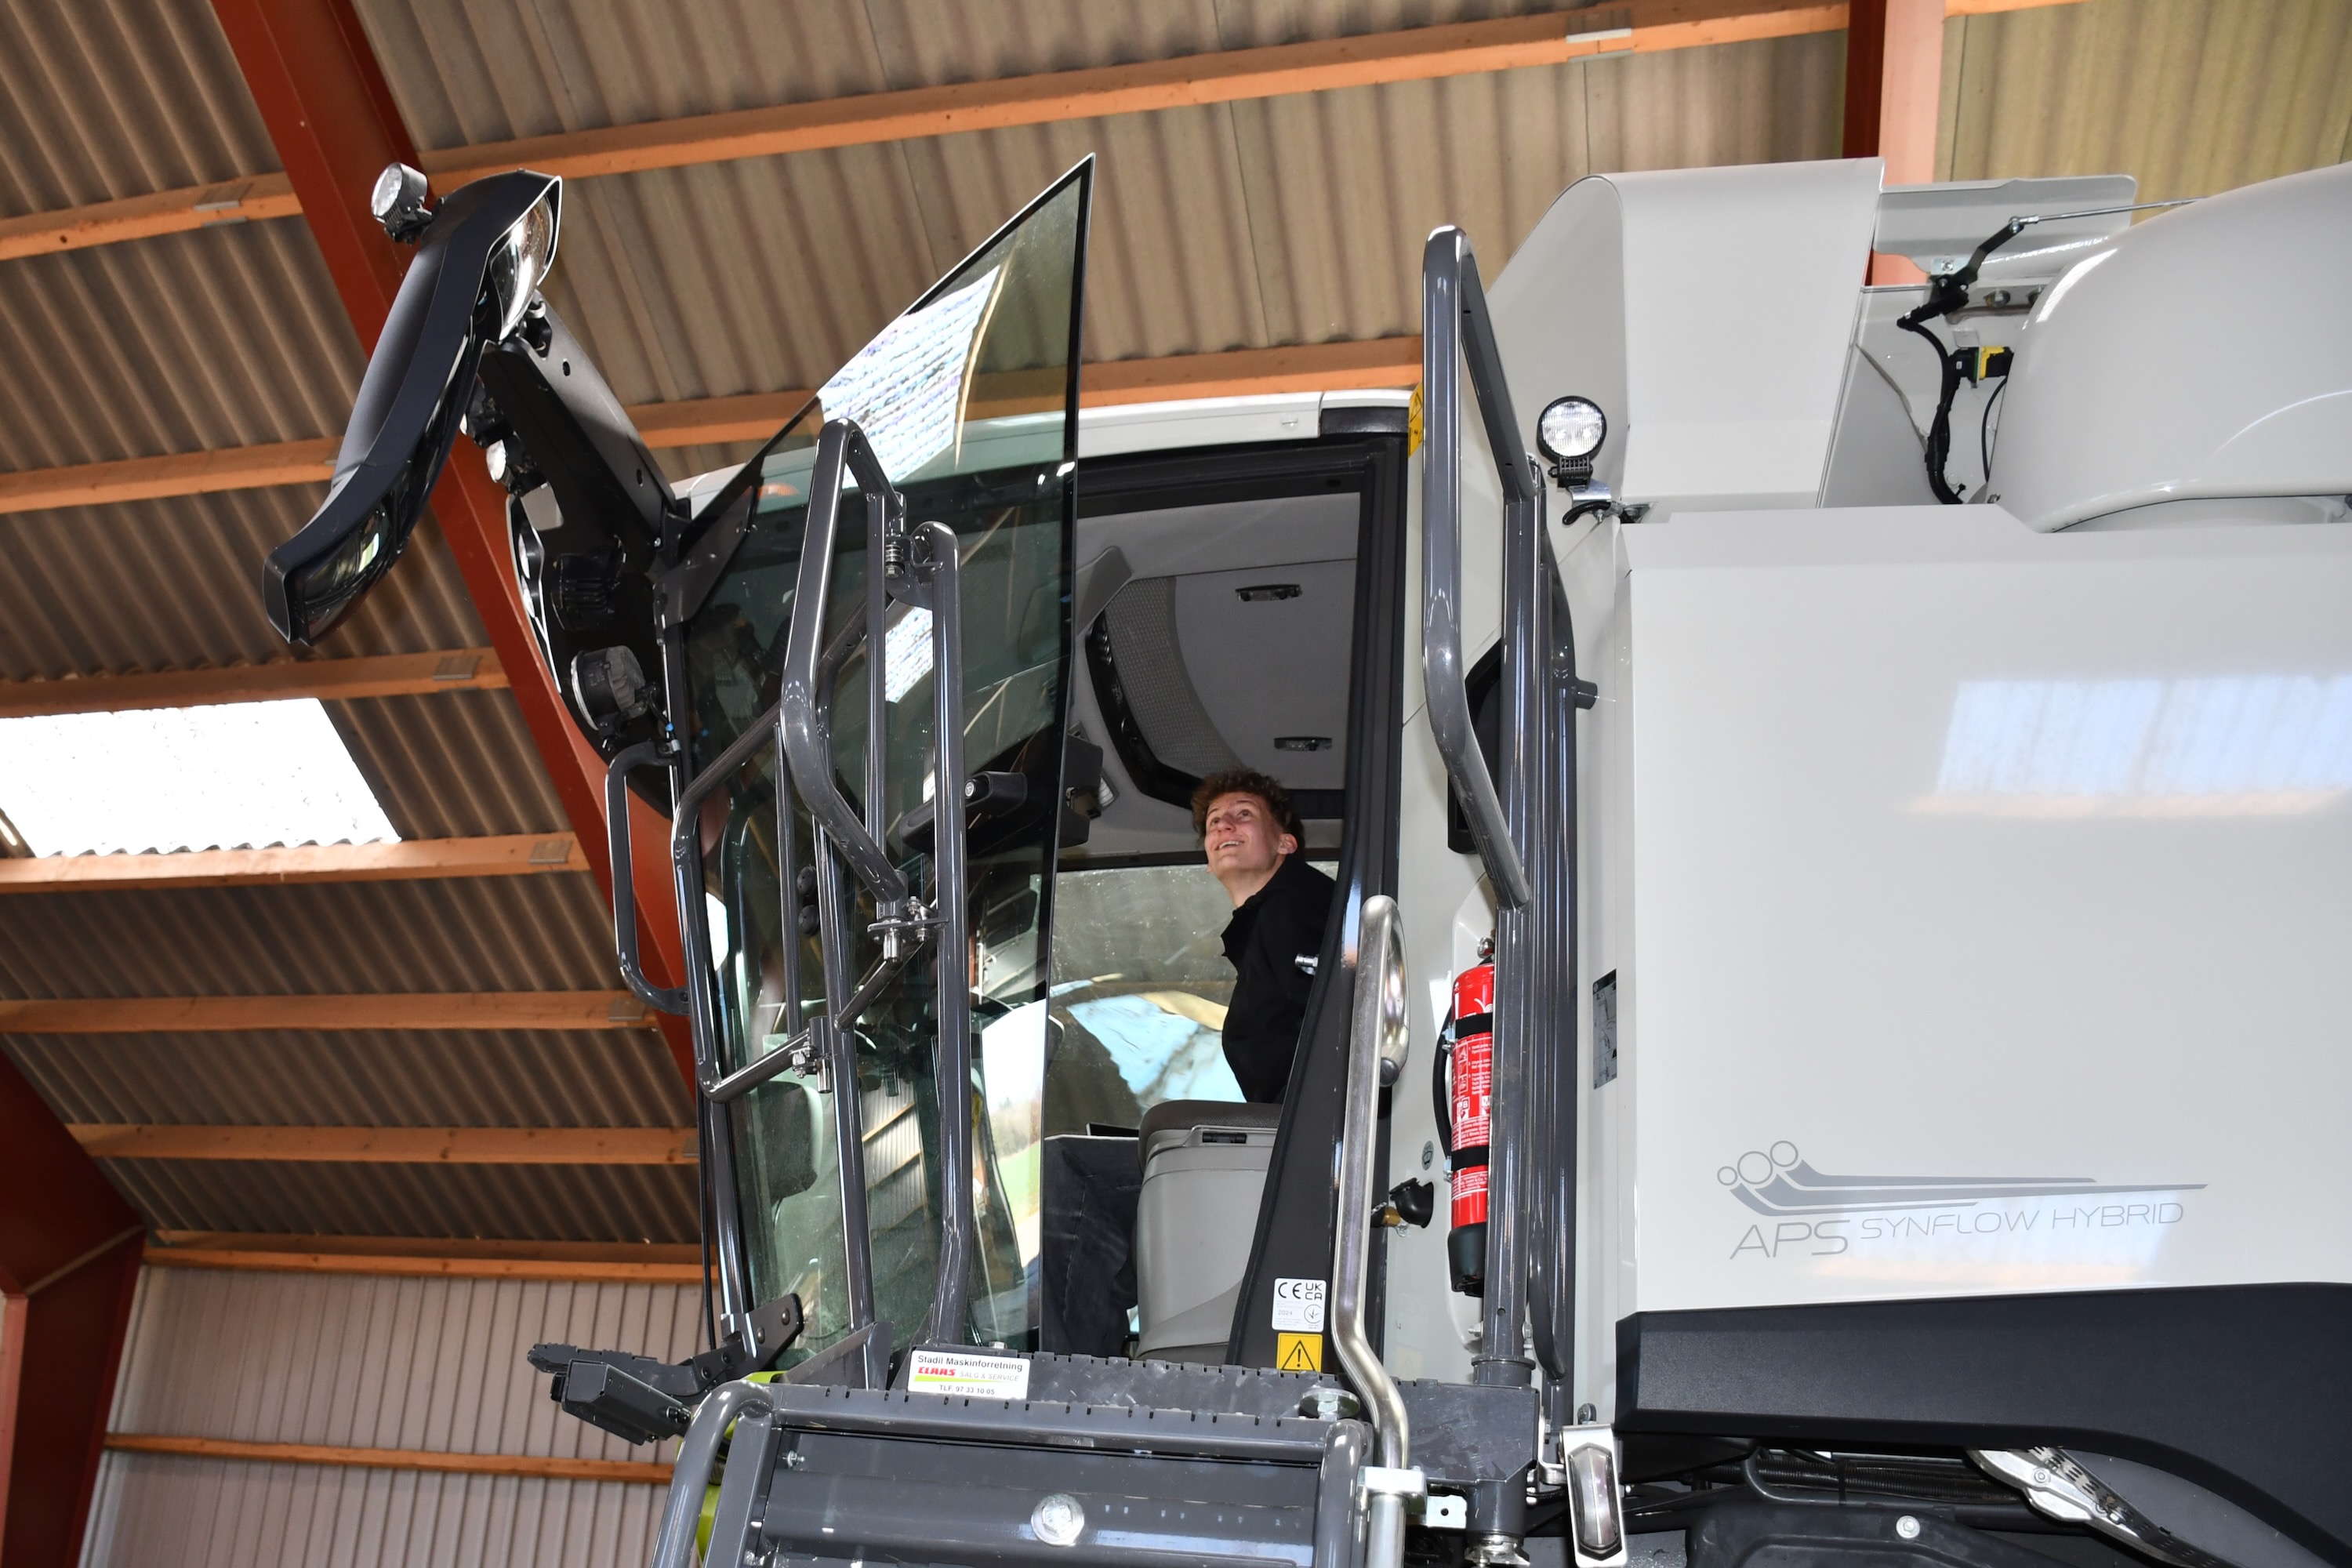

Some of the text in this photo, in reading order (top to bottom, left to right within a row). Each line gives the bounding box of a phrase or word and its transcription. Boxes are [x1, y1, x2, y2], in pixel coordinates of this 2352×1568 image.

[1730, 1203, 2184, 1260] APS SYNFLOW HYBRID
[1278, 1282, 1302, 1299] CE
[1305, 1283, 1323, 1291] UK
[1305, 1292, 1323, 1301] CA
[918, 1355, 1022, 1372] Stadil Maskinforretning
[918, 1367, 956, 1376] CLAAS
